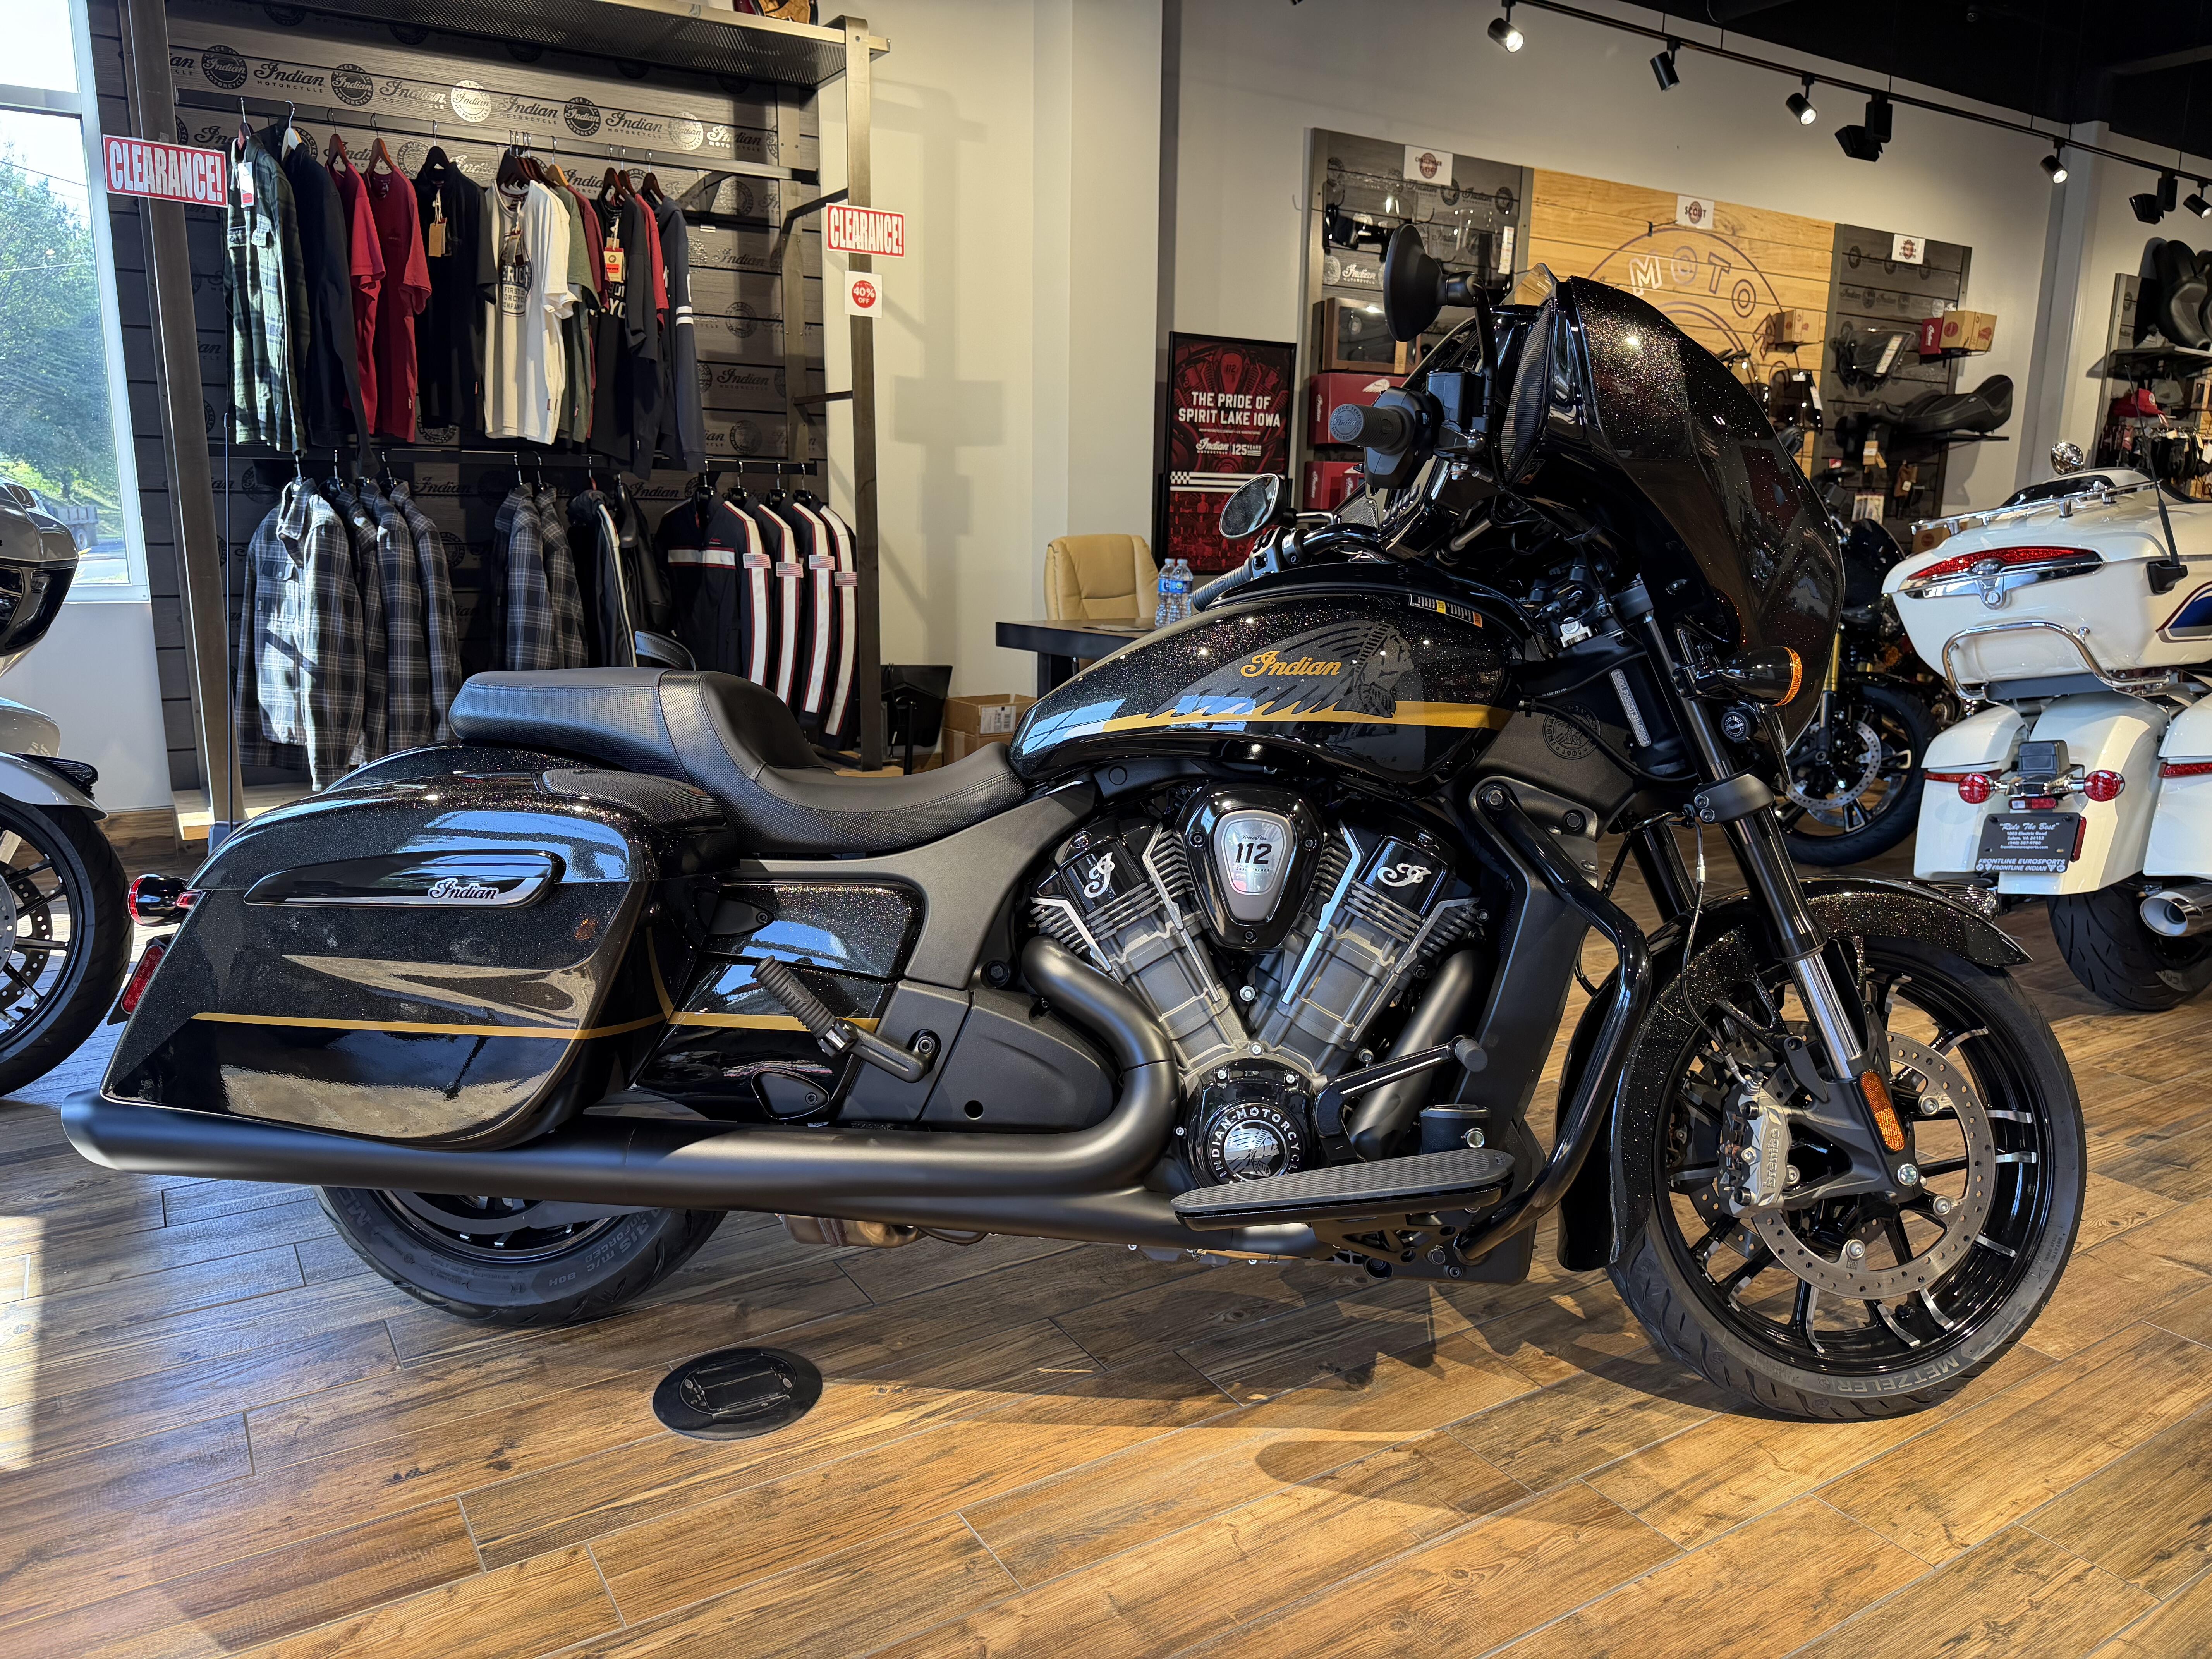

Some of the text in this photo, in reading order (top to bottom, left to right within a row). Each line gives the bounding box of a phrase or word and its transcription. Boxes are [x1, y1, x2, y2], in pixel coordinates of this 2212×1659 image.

[203, 58, 246, 74] Indian
[254, 62, 325, 86] Indian
[204, 71, 246, 88] MOTORCYCLE
[258, 81, 323, 93] MOTORCYCLE
[332, 76, 373, 91] Indian
[334, 88, 372, 105] MOTORCYCLE
[379, 80, 447, 103] Indian
[453, 93, 489, 107] Indian
[497, 96, 558, 118] Indian
[565, 108, 599, 122] Indian
[605, 112, 663, 132] Indian
[608, 128, 661, 139] MOTORCYCLE
[706, 125, 761, 146] Indian
[109, 139, 222, 203] CLEARANCE!
[830, 207, 902, 254] CLEARANCE!
[712, 248, 765, 266] Indian
[1342, 264, 1376, 280] Indian
[504, 287, 520, 295] FIRST
[853, 287, 875, 298] 40%
[717, 368, 769, 386] Indian
[1191, 391, 1271, 410] THE PRIDE OF
[1178, 408, 1281, 428] SPIRIT LAKE IOWA
[1195, 438, 1230, 451] Indian
[1231, 443, 1248, 456] 125
[630, 481, 679, 498] Indian
[1240, 651, 1343, 678] Indian
[2023, 822, 2037, 830] The
[1235, 842, 1273, 865] 112
[429, 878, 499, 900] Indian
[1212, 1106, 1300, 1177] INDIAN MOTORCYCL
[1763, 1128, 1780, 1188] brembo
[549, 1272, 577, 1286] 80H
[1838, 1355, 1960, 1393] METZELER
